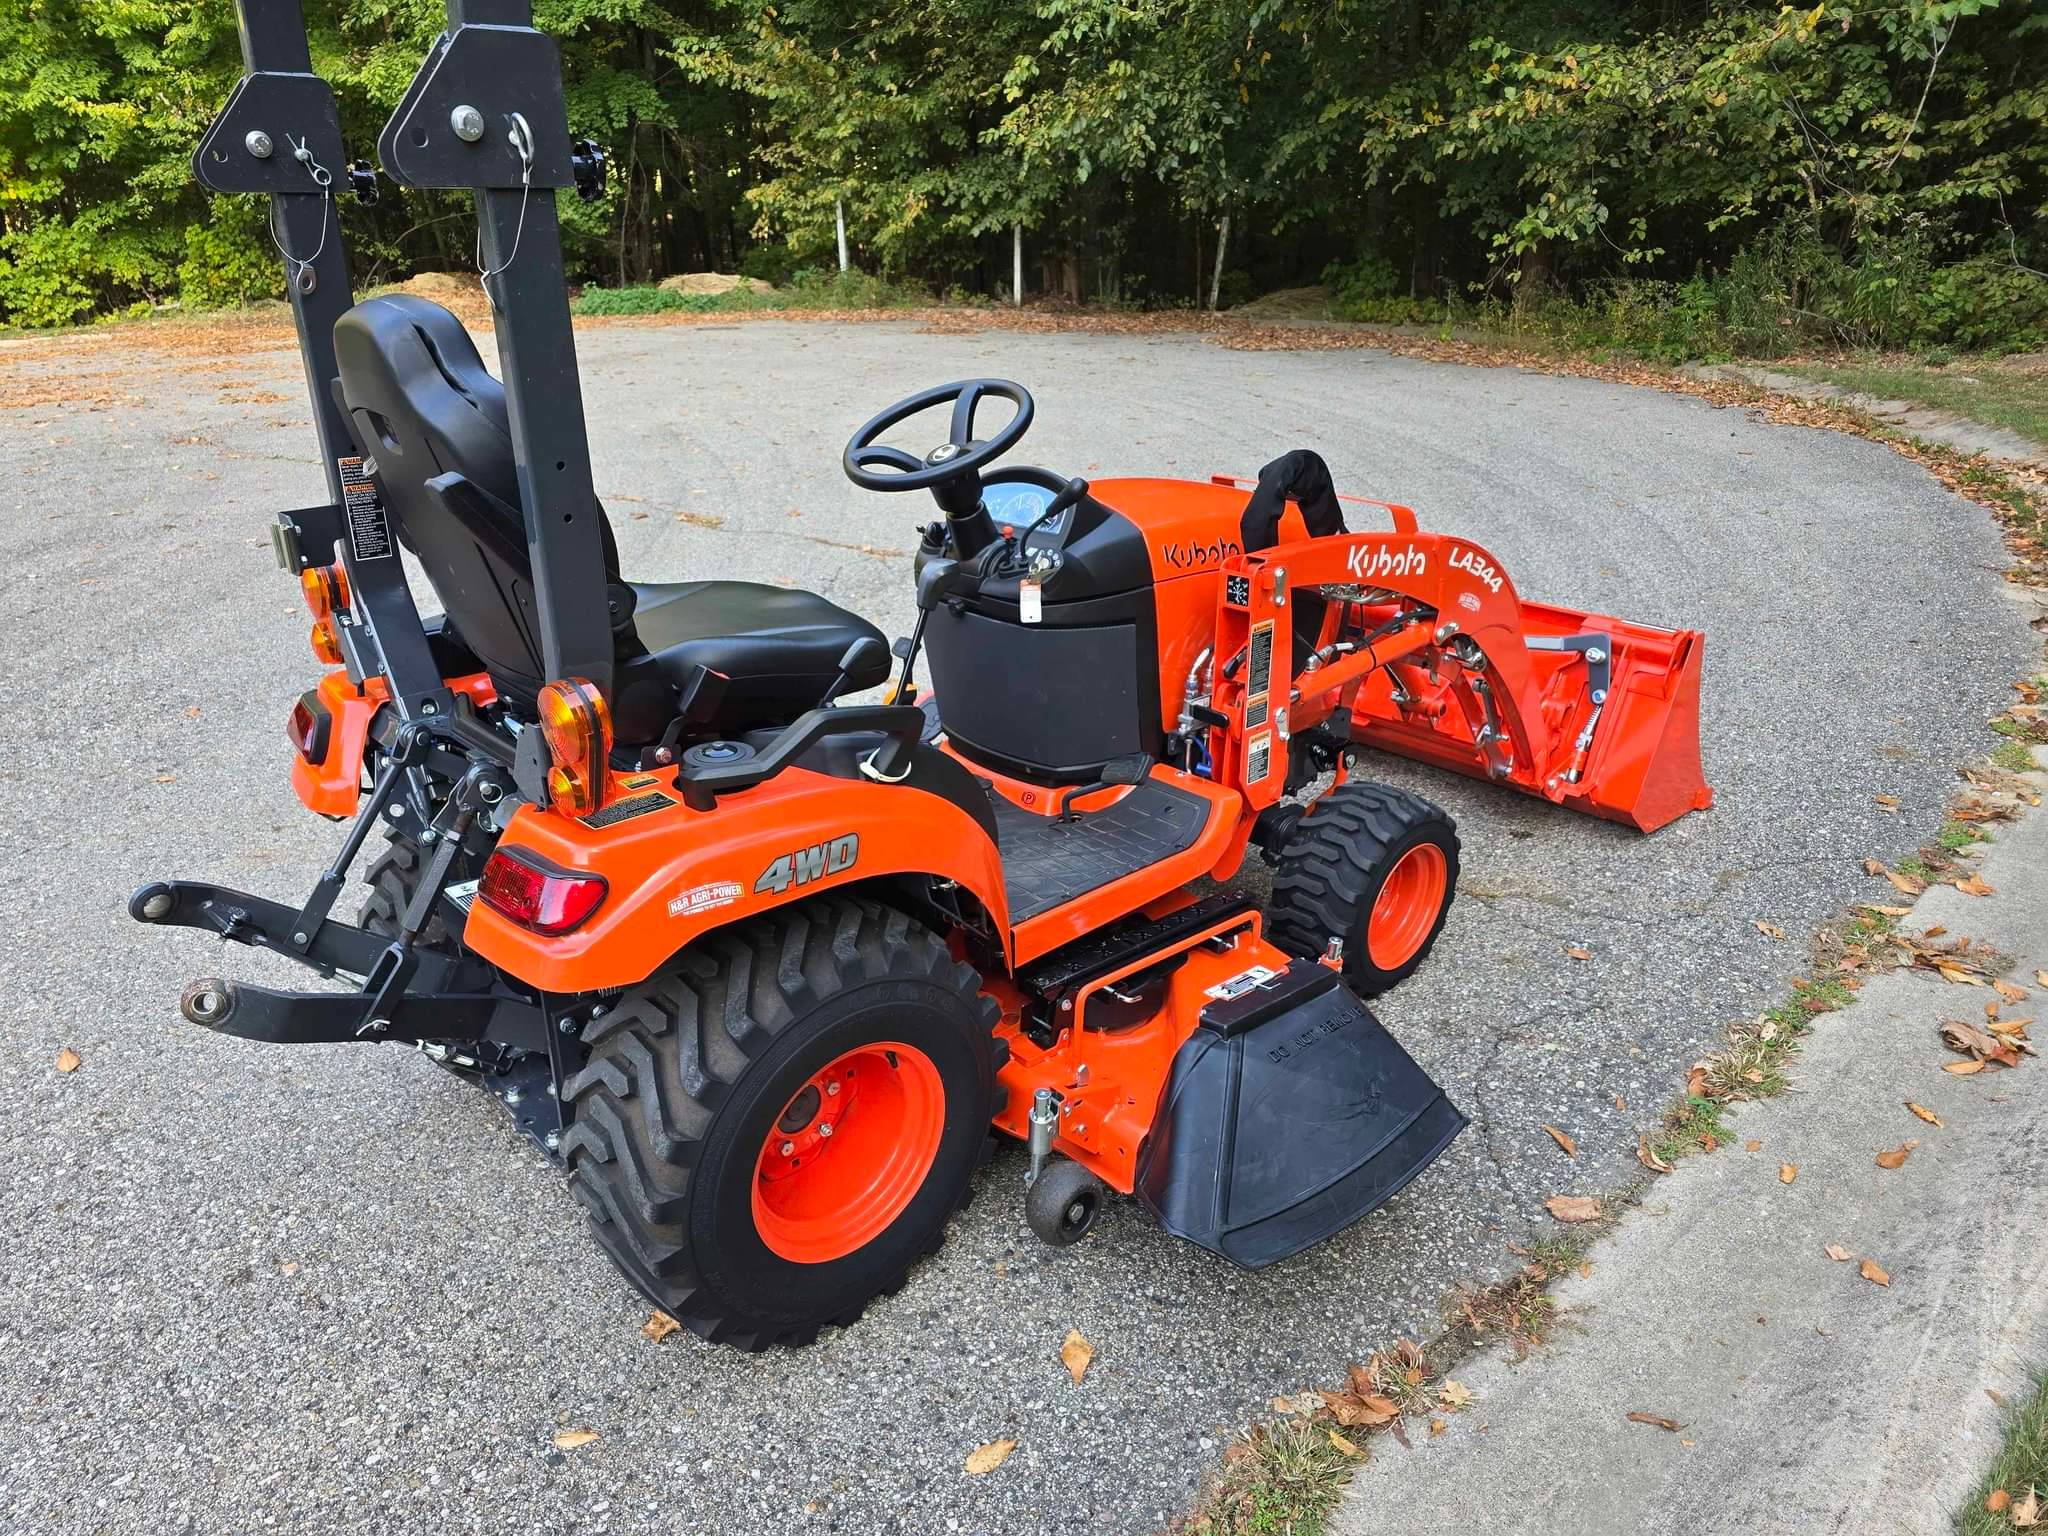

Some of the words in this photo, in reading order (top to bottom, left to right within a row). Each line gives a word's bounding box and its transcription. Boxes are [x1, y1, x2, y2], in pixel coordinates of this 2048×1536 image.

[1347, 544, 1426, 577] Kubota
[1448, 547, 1504, 594] LA344
[753, 832, 859, 895] 4WD
[670, 896, 690, 914] H&R
[691, 884, 743, 906] AGRI-POWER
[1267, 1045, 1291, 1064] DO
[1295, 1029, 1320, 1050] NOT
[1319, 1006, 1365, 1035] REMOVE
